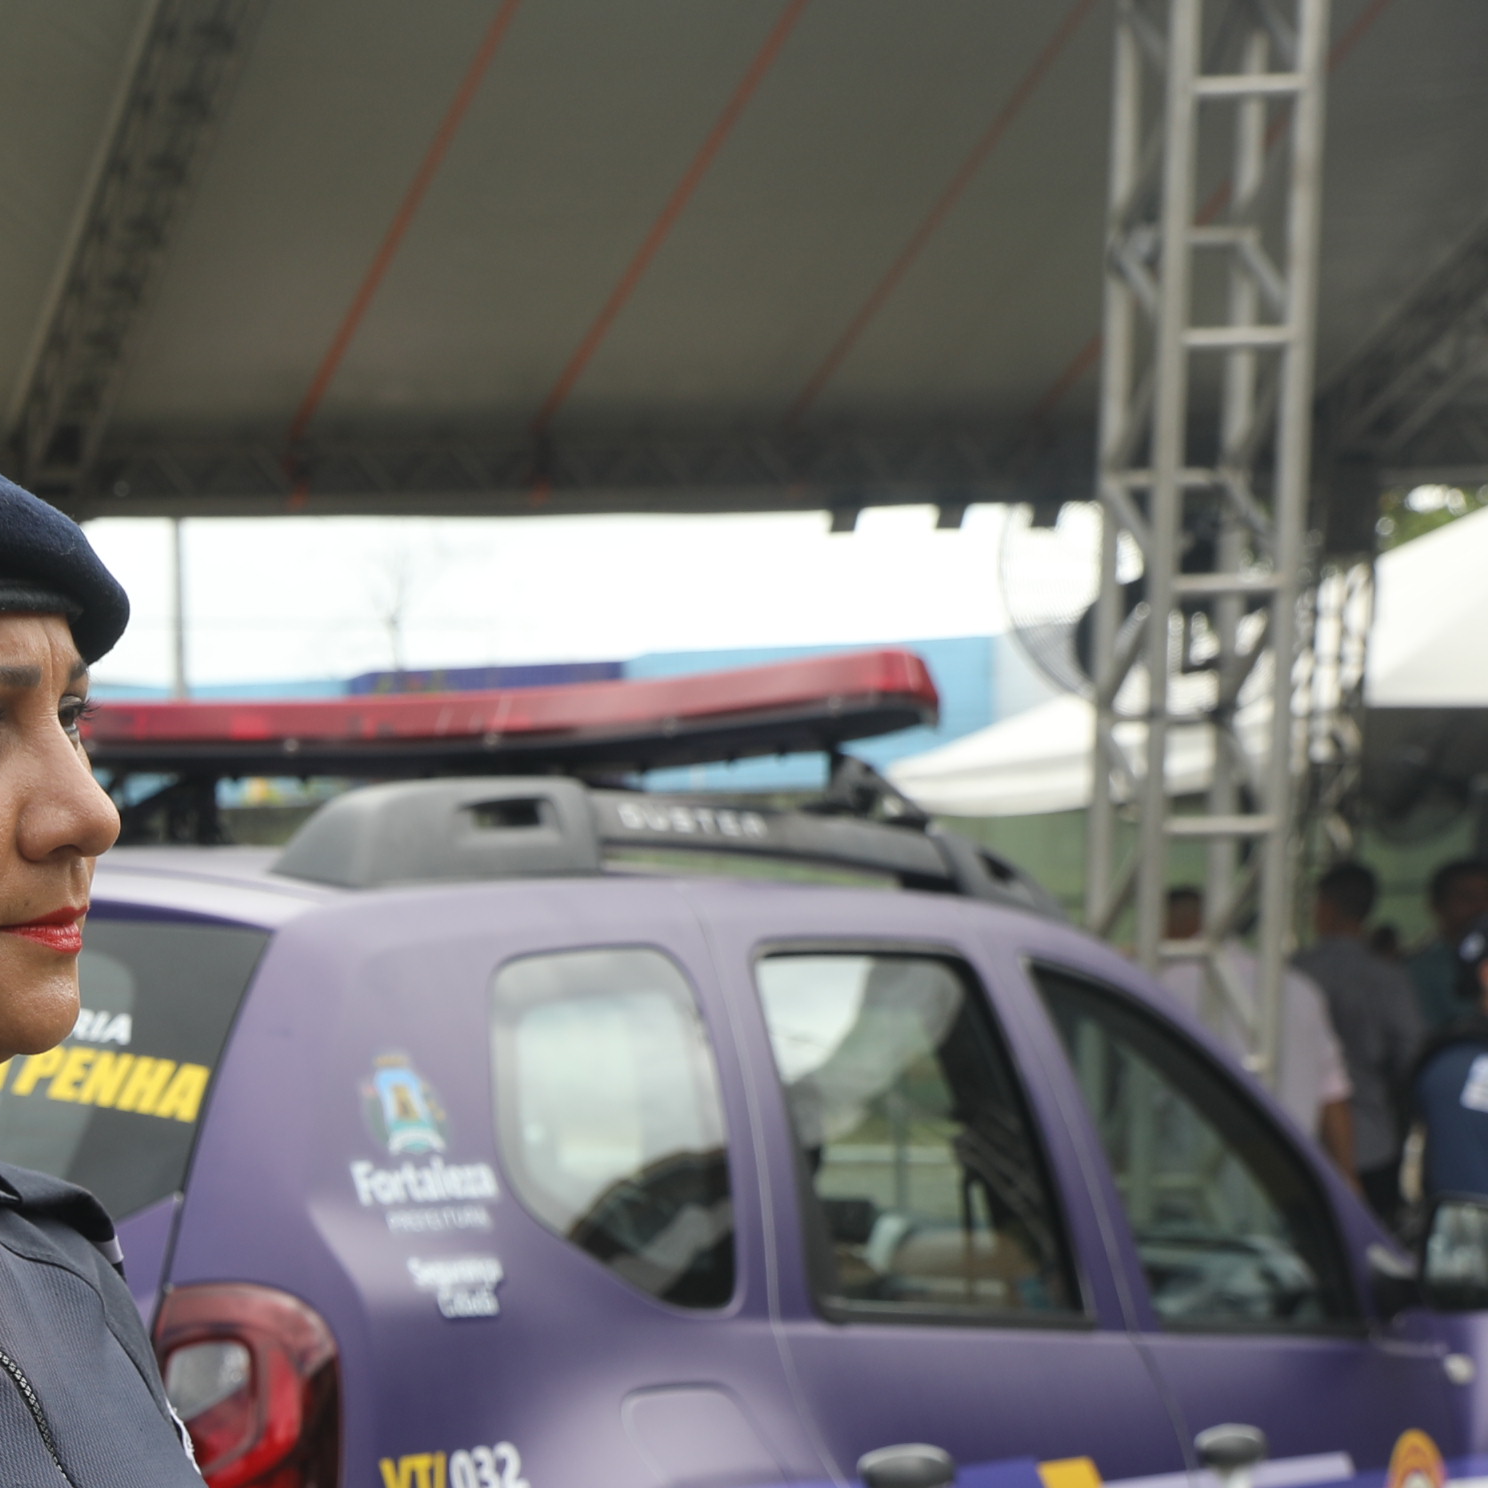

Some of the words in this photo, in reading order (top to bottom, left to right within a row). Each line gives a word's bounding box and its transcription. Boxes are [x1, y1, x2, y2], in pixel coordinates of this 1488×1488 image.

[616, 802, 768, 838] DUSTER
[11, 1045, 211, 1123] PENHA
[349, 1155, 499, 1206] Fortaleza
